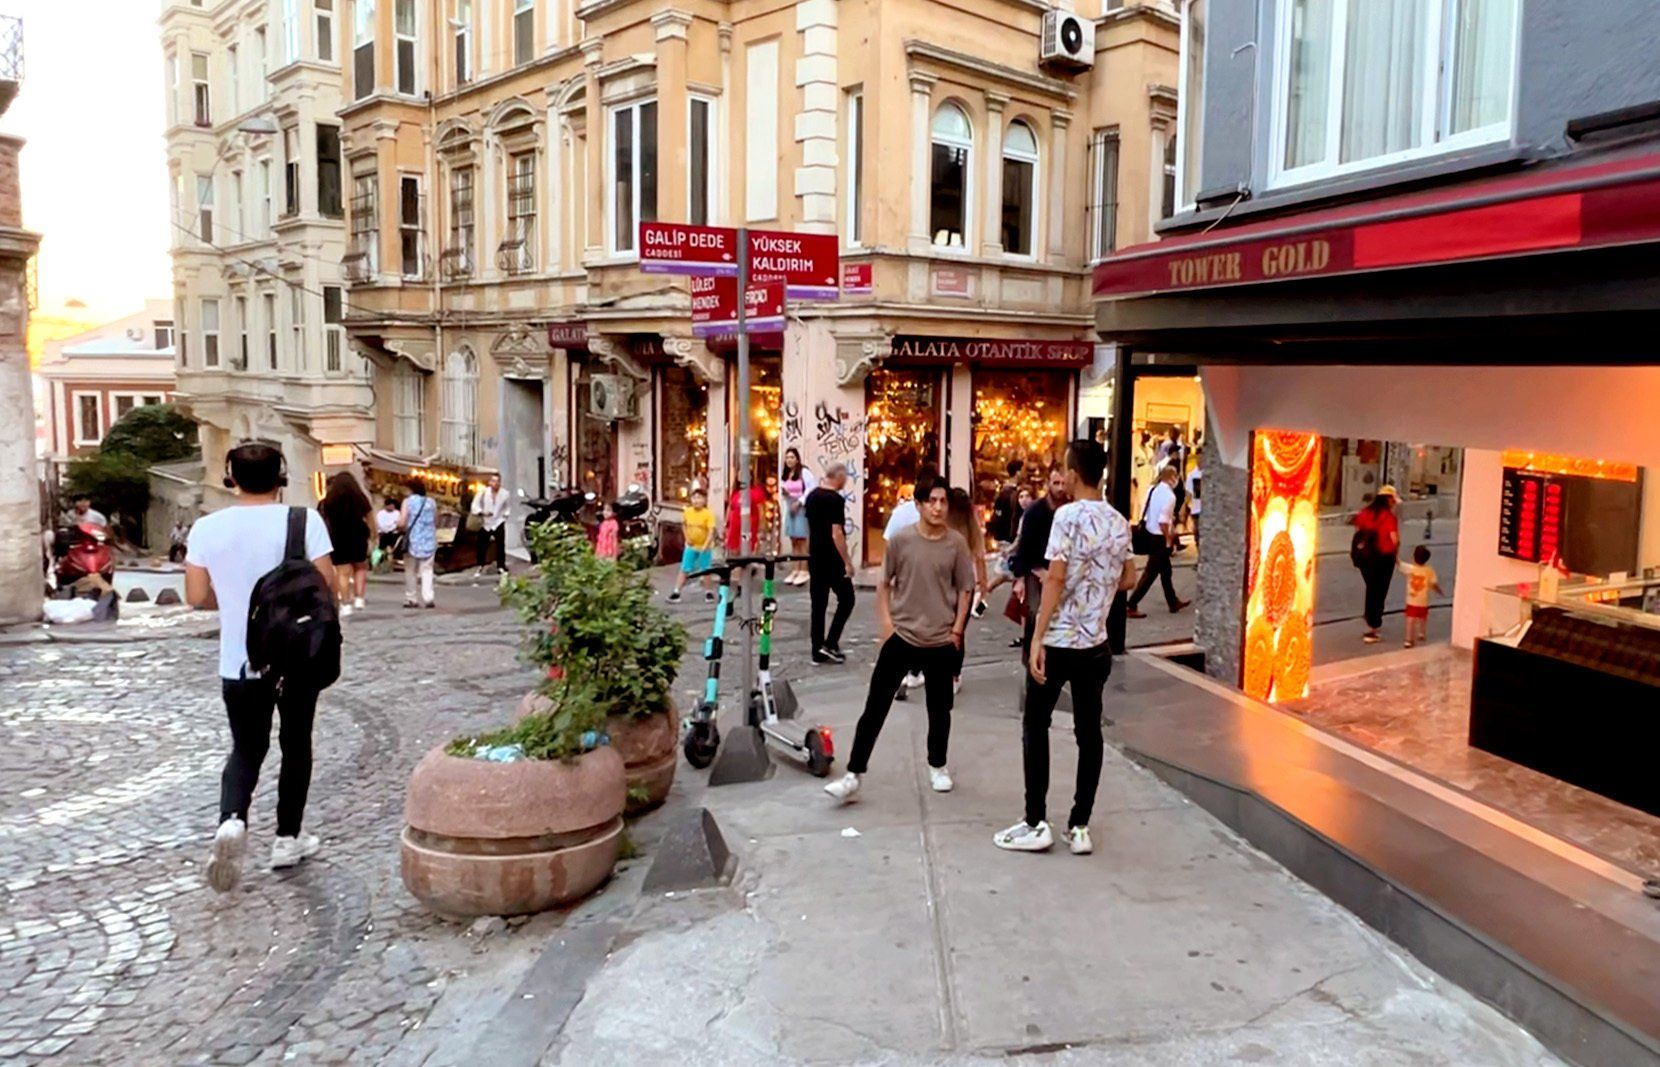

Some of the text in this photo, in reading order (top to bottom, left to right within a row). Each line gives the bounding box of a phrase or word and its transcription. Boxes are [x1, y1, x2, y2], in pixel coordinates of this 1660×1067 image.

[645, 229, 724, 249] GALİP DEDE
[751, 235, 802, 254] YÜKSEK
[752, 256, 814, 273] KALDIRIM
[1168, 240, 1330, 286] TOWER GOLD
[891, 340, 1089, 361] ALATA OTANTİK SHOP
